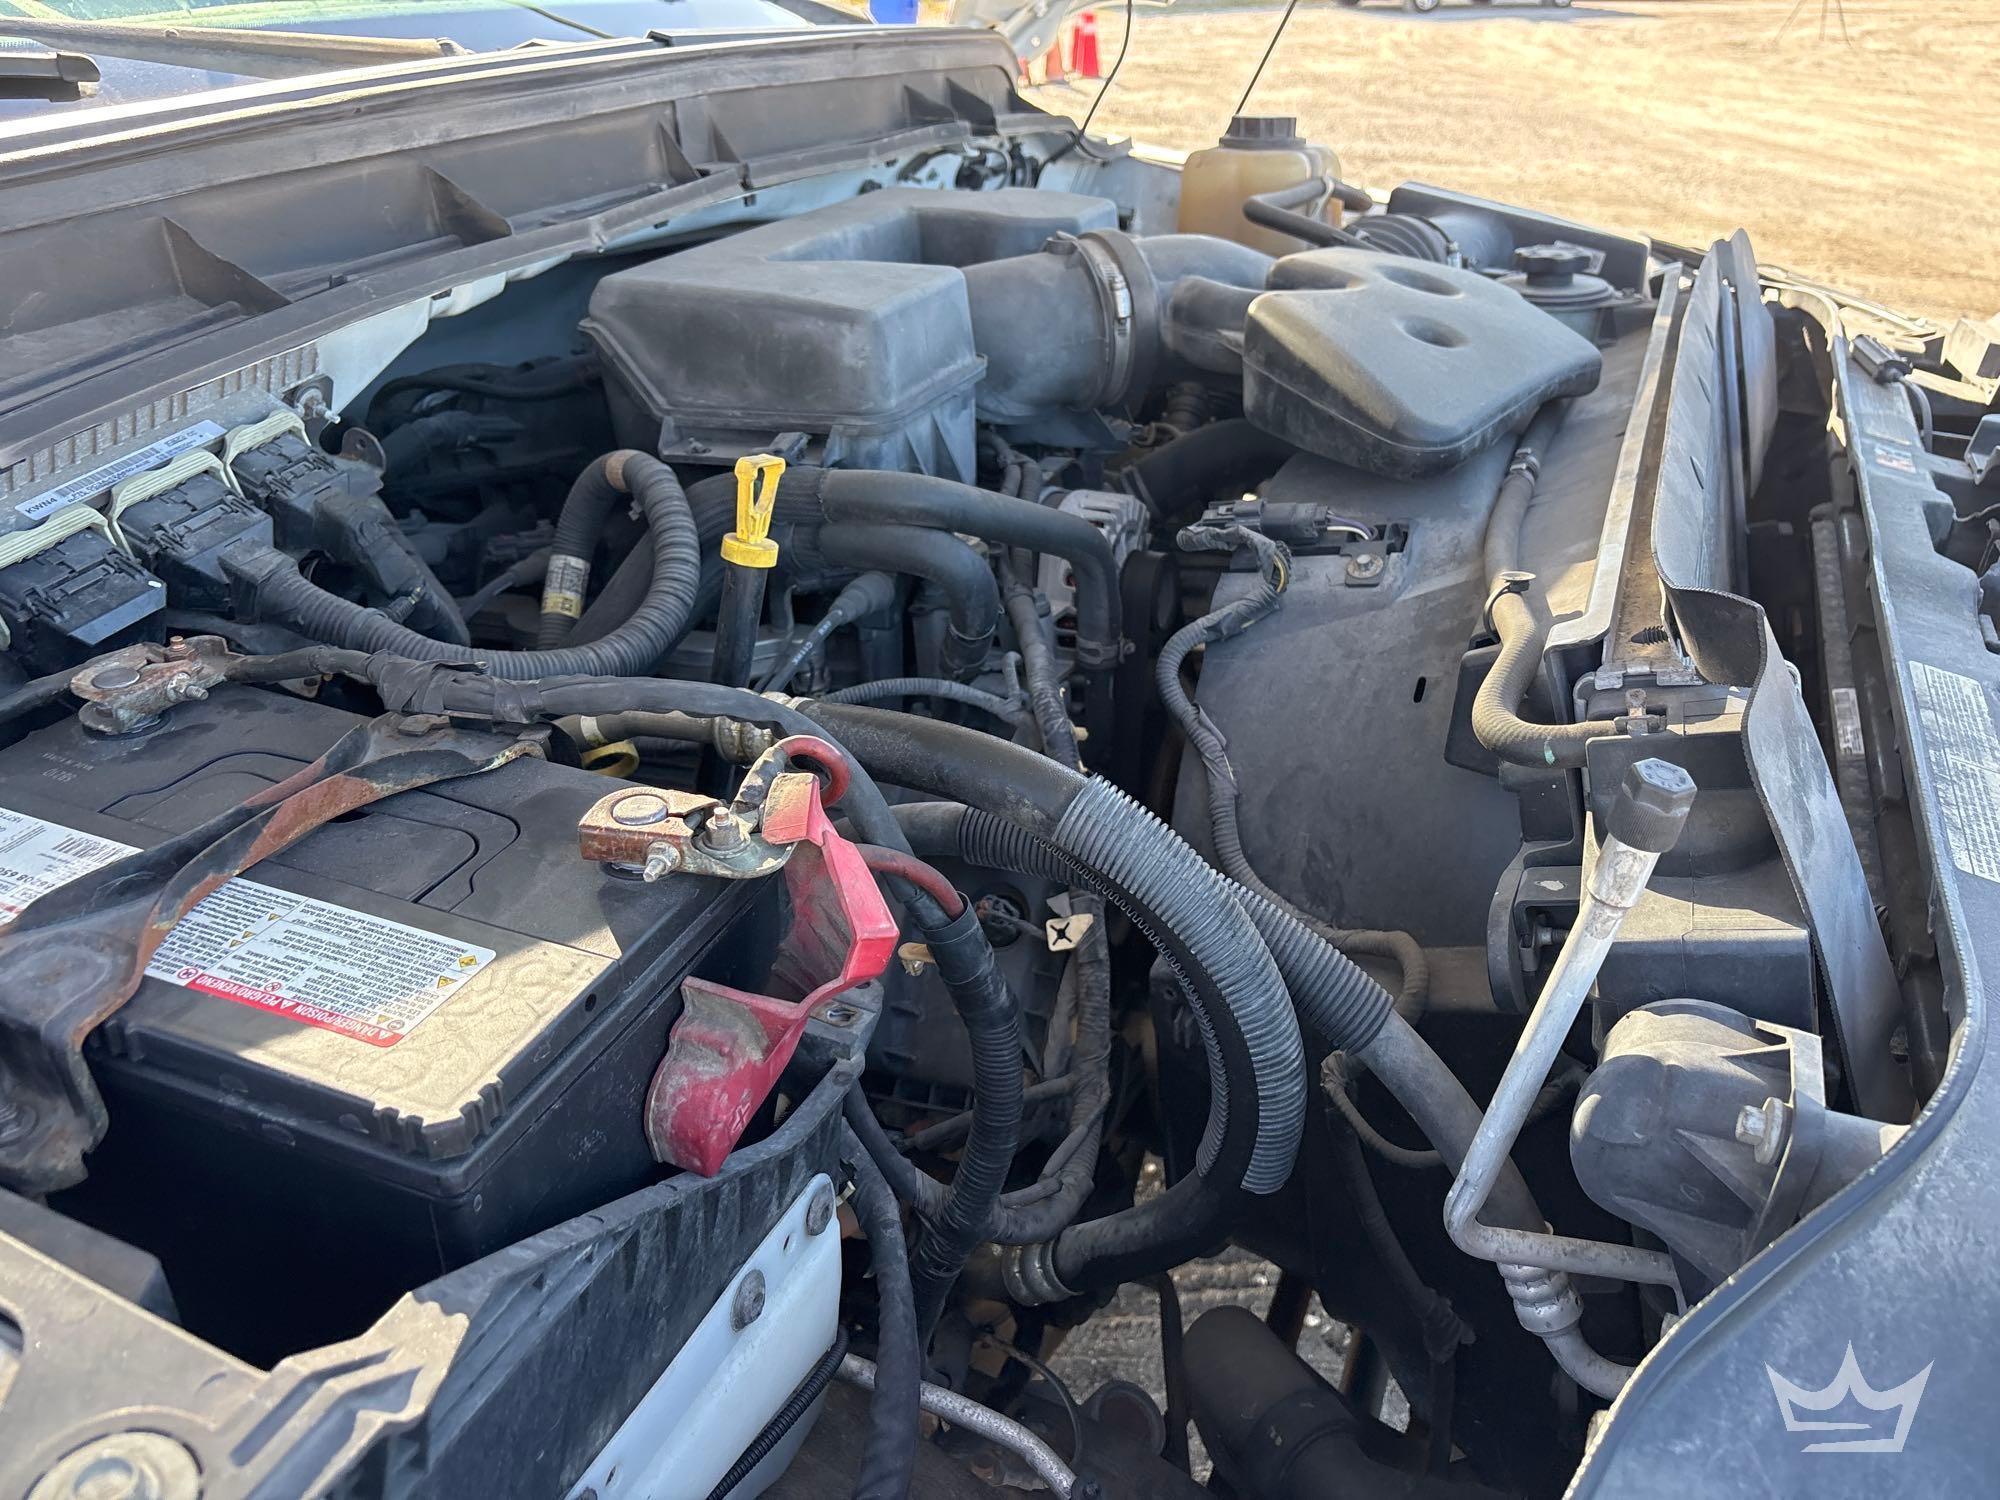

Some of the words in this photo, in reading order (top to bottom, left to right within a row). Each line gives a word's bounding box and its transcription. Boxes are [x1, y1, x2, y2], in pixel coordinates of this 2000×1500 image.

[24, 496, 59, 514] KWN4
[193, 974, 283, 1006] PELIGRO/VENENO
[290, 1003, 381, 1036] DANGER/POISON
